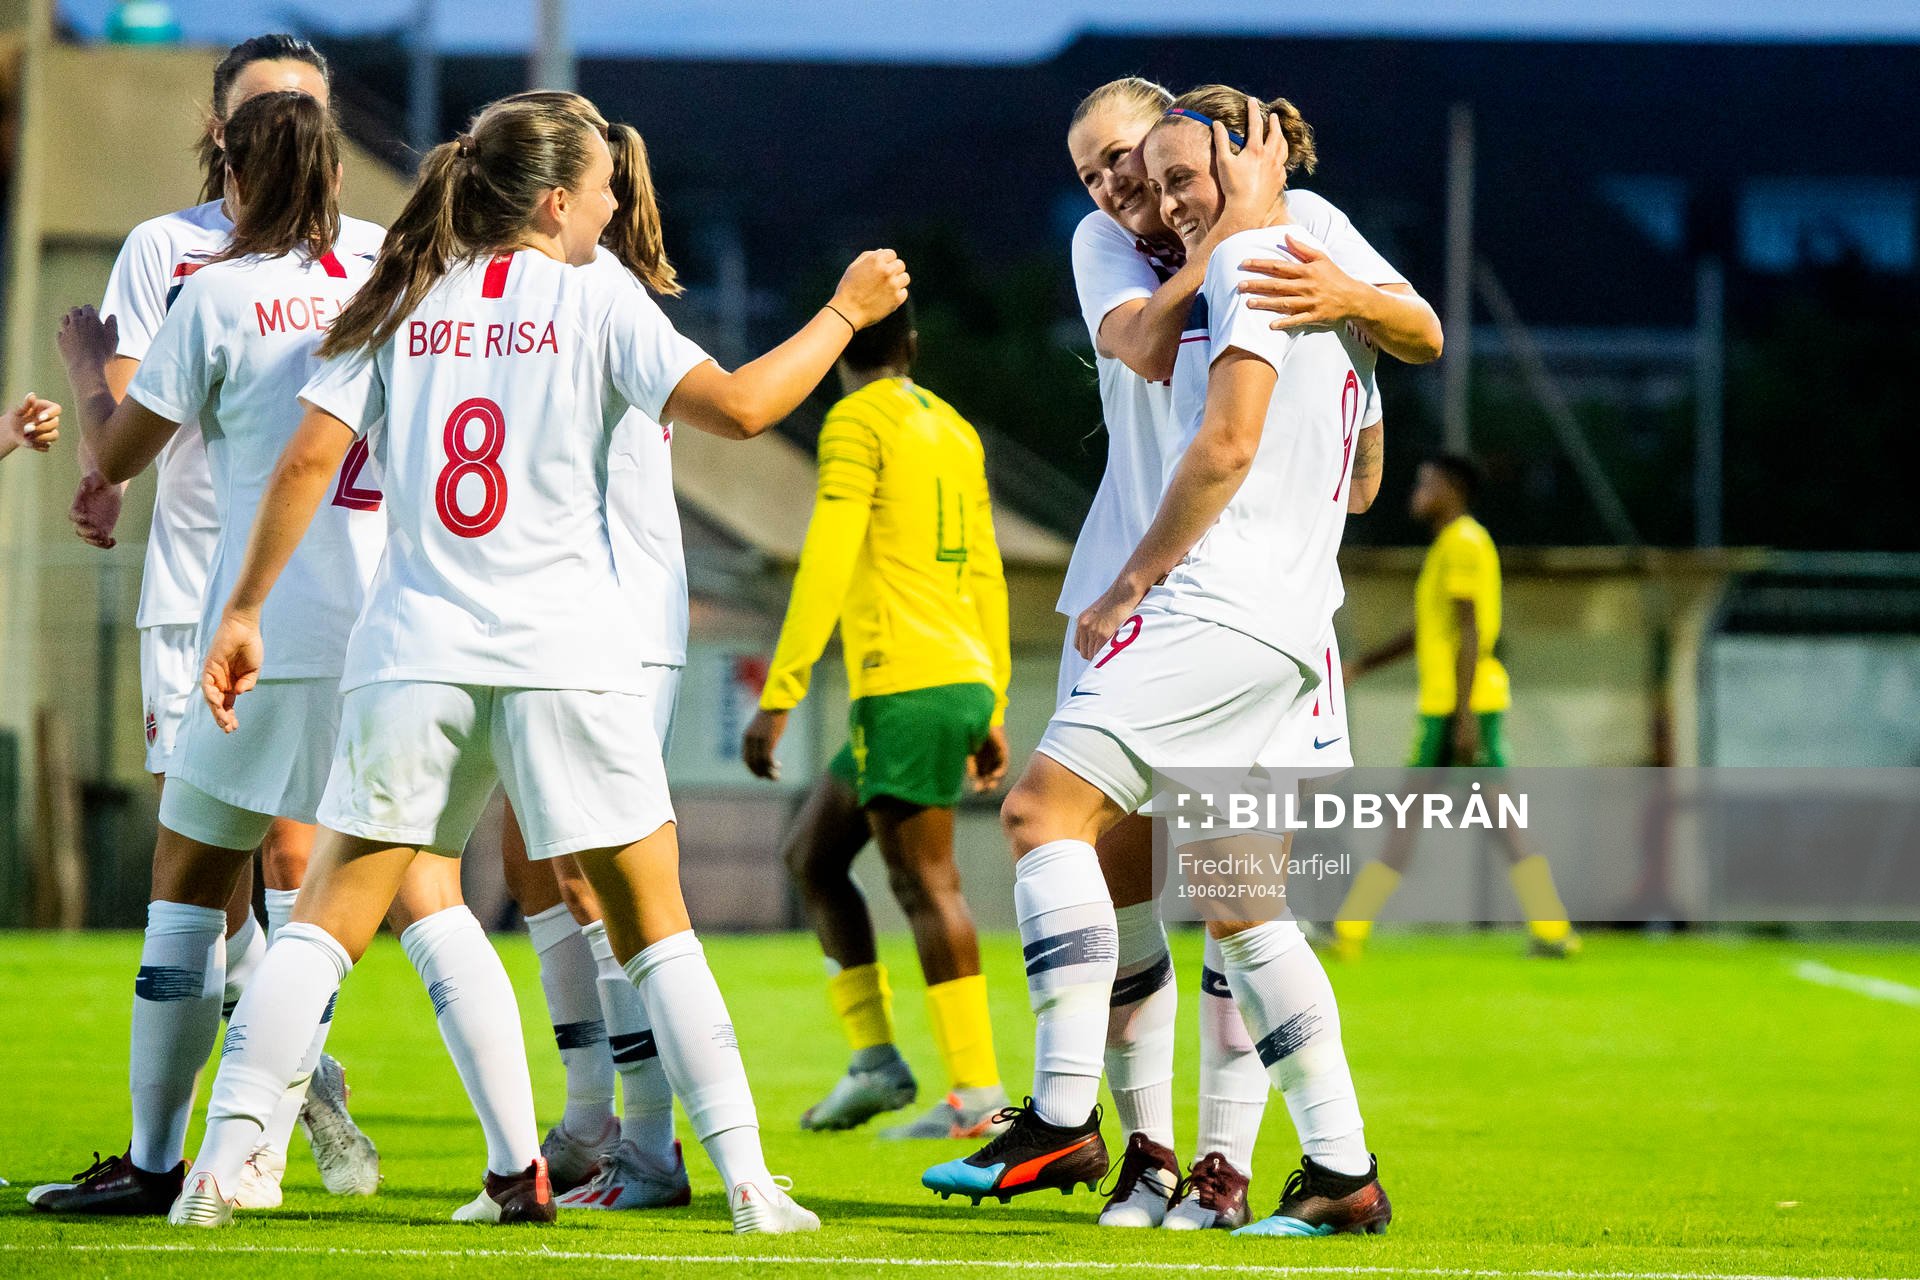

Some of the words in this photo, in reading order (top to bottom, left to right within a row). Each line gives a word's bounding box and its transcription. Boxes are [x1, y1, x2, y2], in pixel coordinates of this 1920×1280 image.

[255, 296, 329, 336] MOE
[409, 320, 475, 357] BØE
[485, 320, 559, 358] RISA
[435, 397, 508, 539] 8
[936, 477, 968, 595] 4
[1094, 614, 1143, 669] 9
